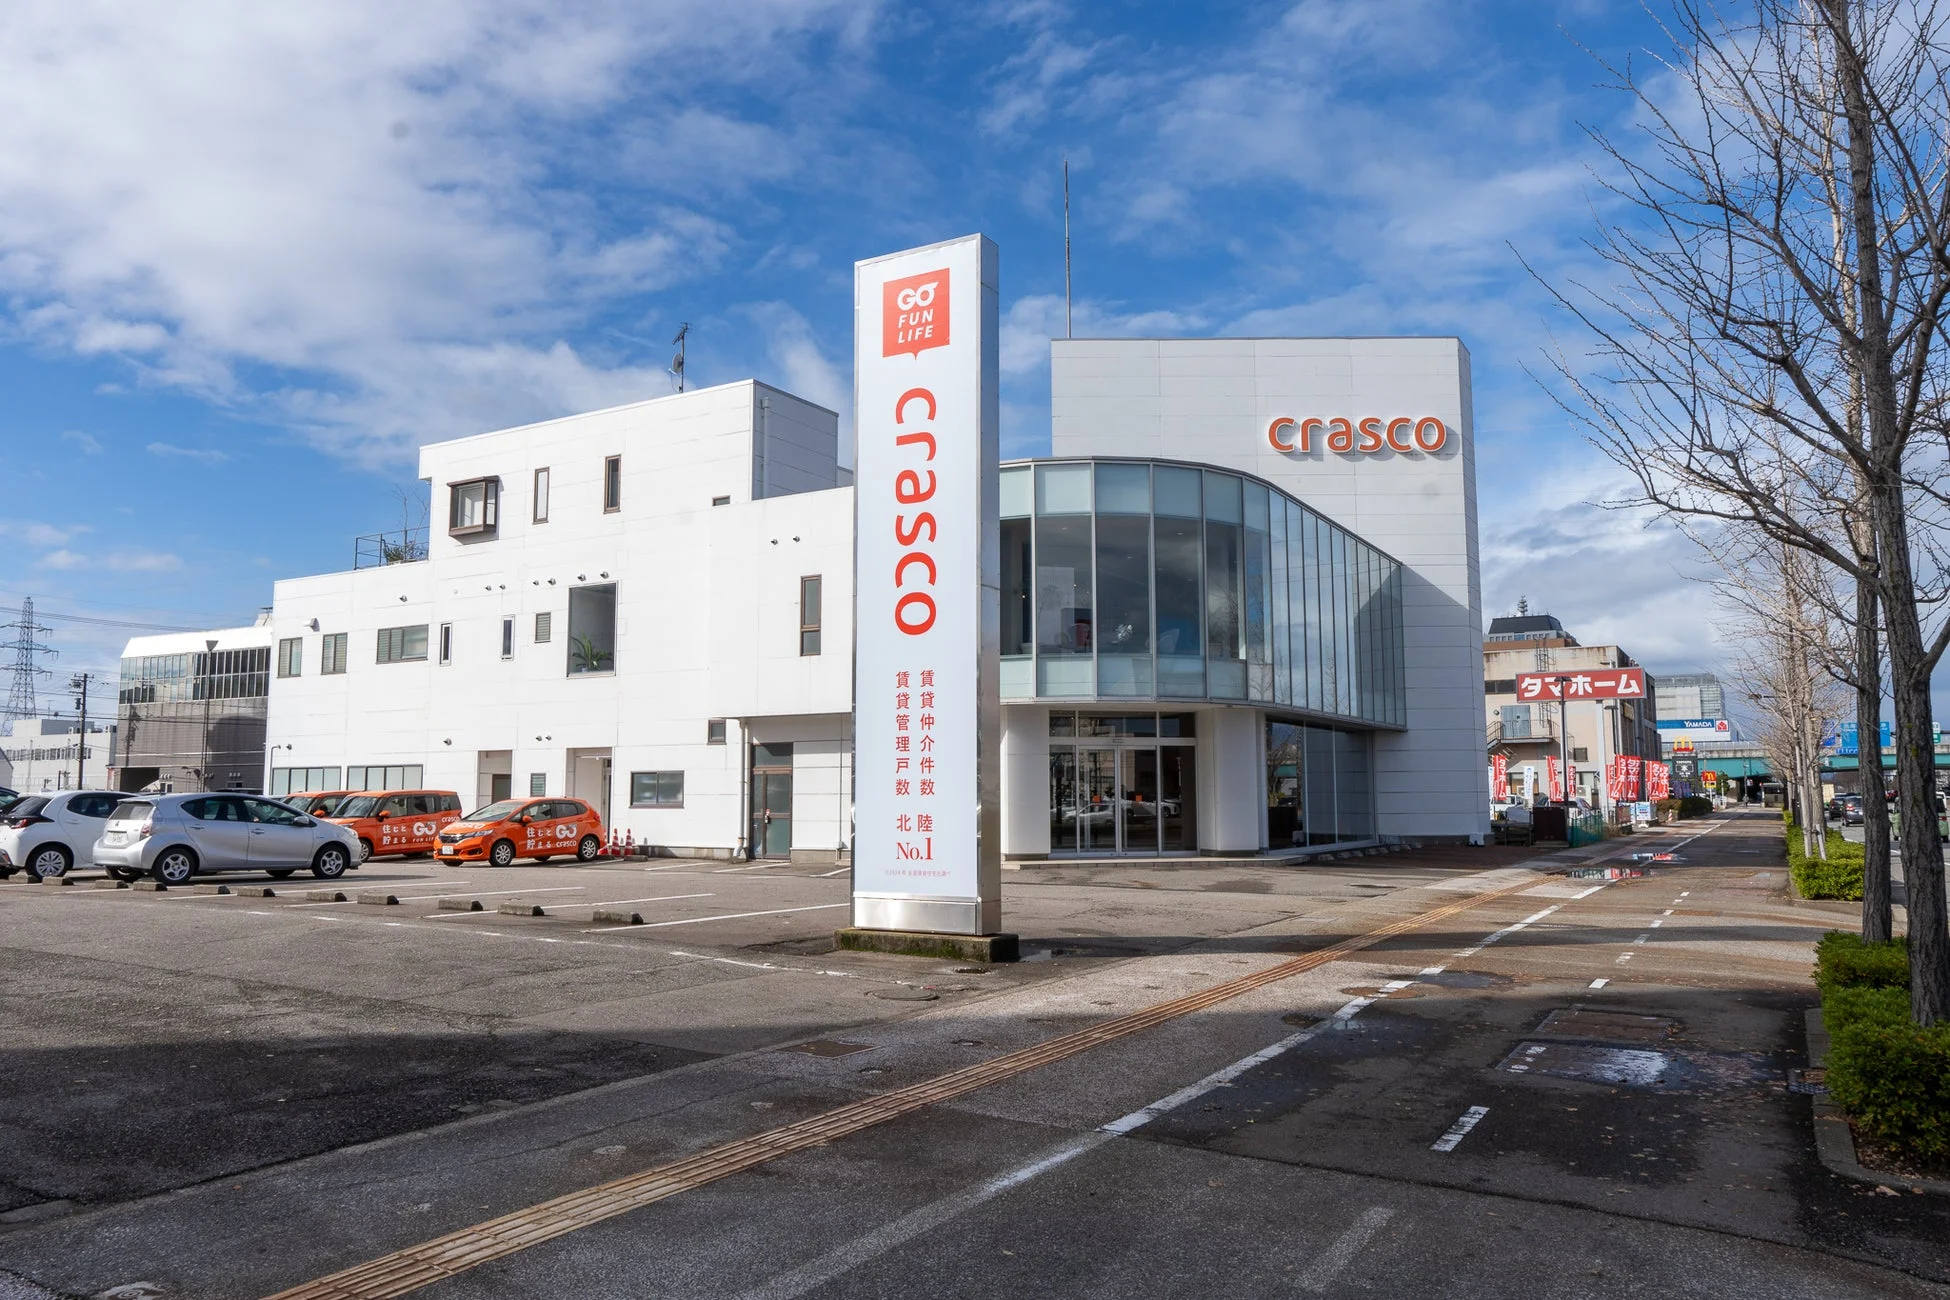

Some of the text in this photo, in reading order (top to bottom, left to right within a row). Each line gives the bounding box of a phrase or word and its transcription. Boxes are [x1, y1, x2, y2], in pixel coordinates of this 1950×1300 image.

[897, 282, 939, 311] GO
[898, 308, 934, 328] FUN
[898, 325, 934, 344] LIFE
[1268, 416, 1447, 453] crasco
[895, 387, 937, 636] crasco
[1521, 673, 1640, 698] タマホーム
[895, 671, 910, 796] 賃貸管理戸数
[919, 669, 935, 796] 賃貸仲介件数
[1684, 720, 1712, 728] YAMADA
[527, 826, 552, 838] 住むと
[556, 840, 577, 848] crasco
[896, 838, 933, 860] No.1
